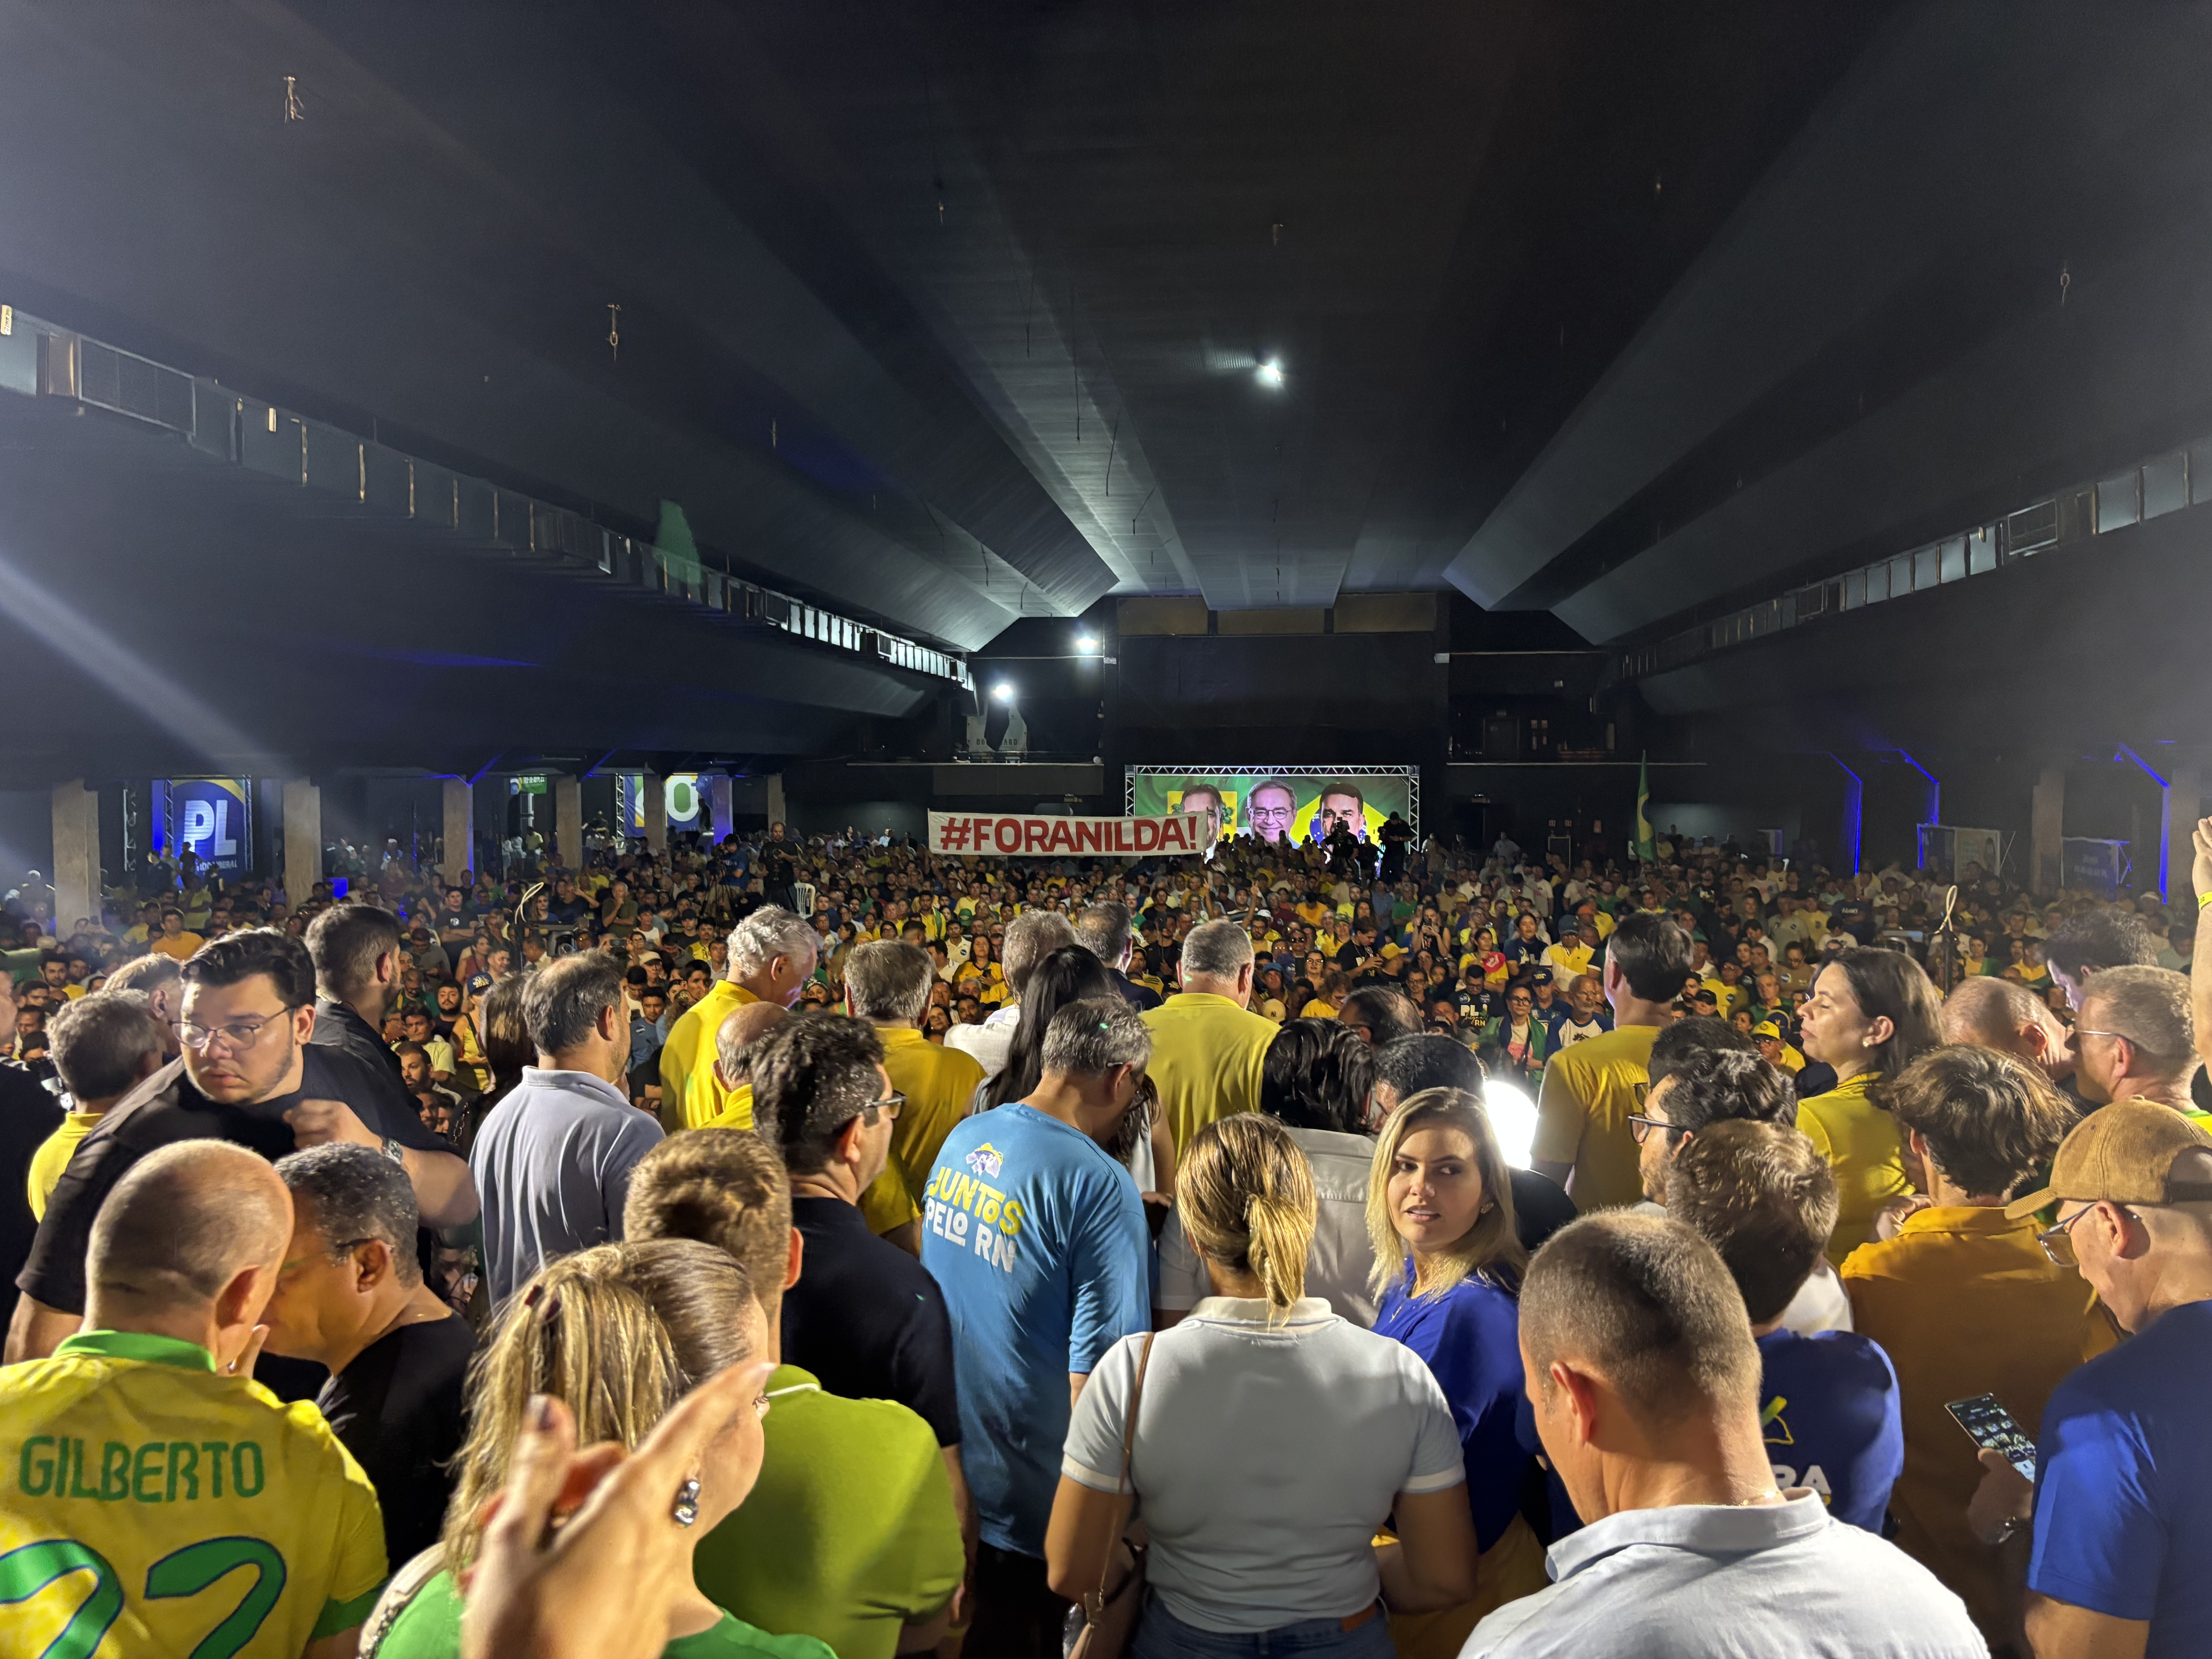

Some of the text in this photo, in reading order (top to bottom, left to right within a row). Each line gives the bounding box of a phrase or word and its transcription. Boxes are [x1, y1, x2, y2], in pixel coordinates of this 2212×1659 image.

[184, 800, 237, 856] PL
[940, 816, 1197, 853] #FORANILDA!
[928, 1166, 1025, 1235] JUNTOS
[925, 1197, 1018, 1273] PELO RN
[19, 1435, 265, 1503] GILBERTO
